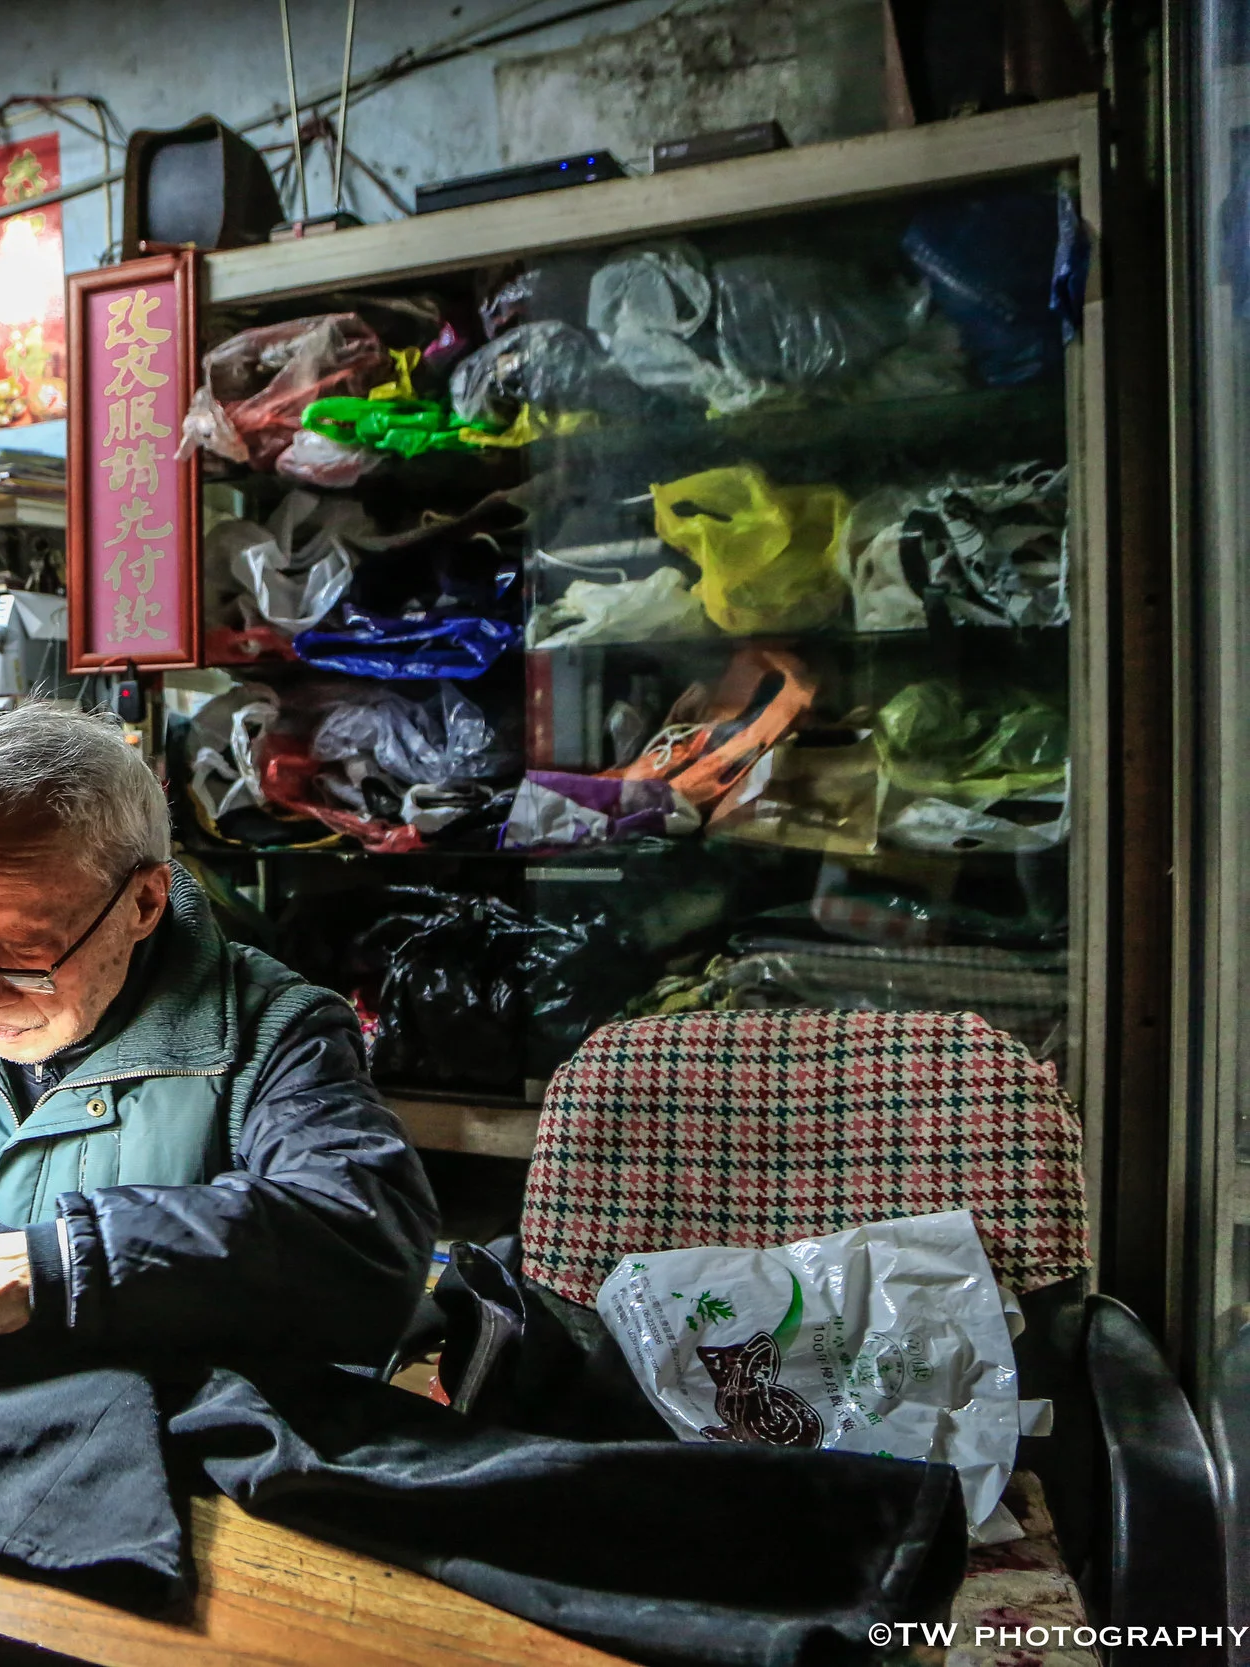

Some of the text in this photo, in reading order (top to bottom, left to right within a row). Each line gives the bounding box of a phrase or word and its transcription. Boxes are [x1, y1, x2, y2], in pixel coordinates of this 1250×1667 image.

[100, 289, 173, 644] 改衣服請先付款
